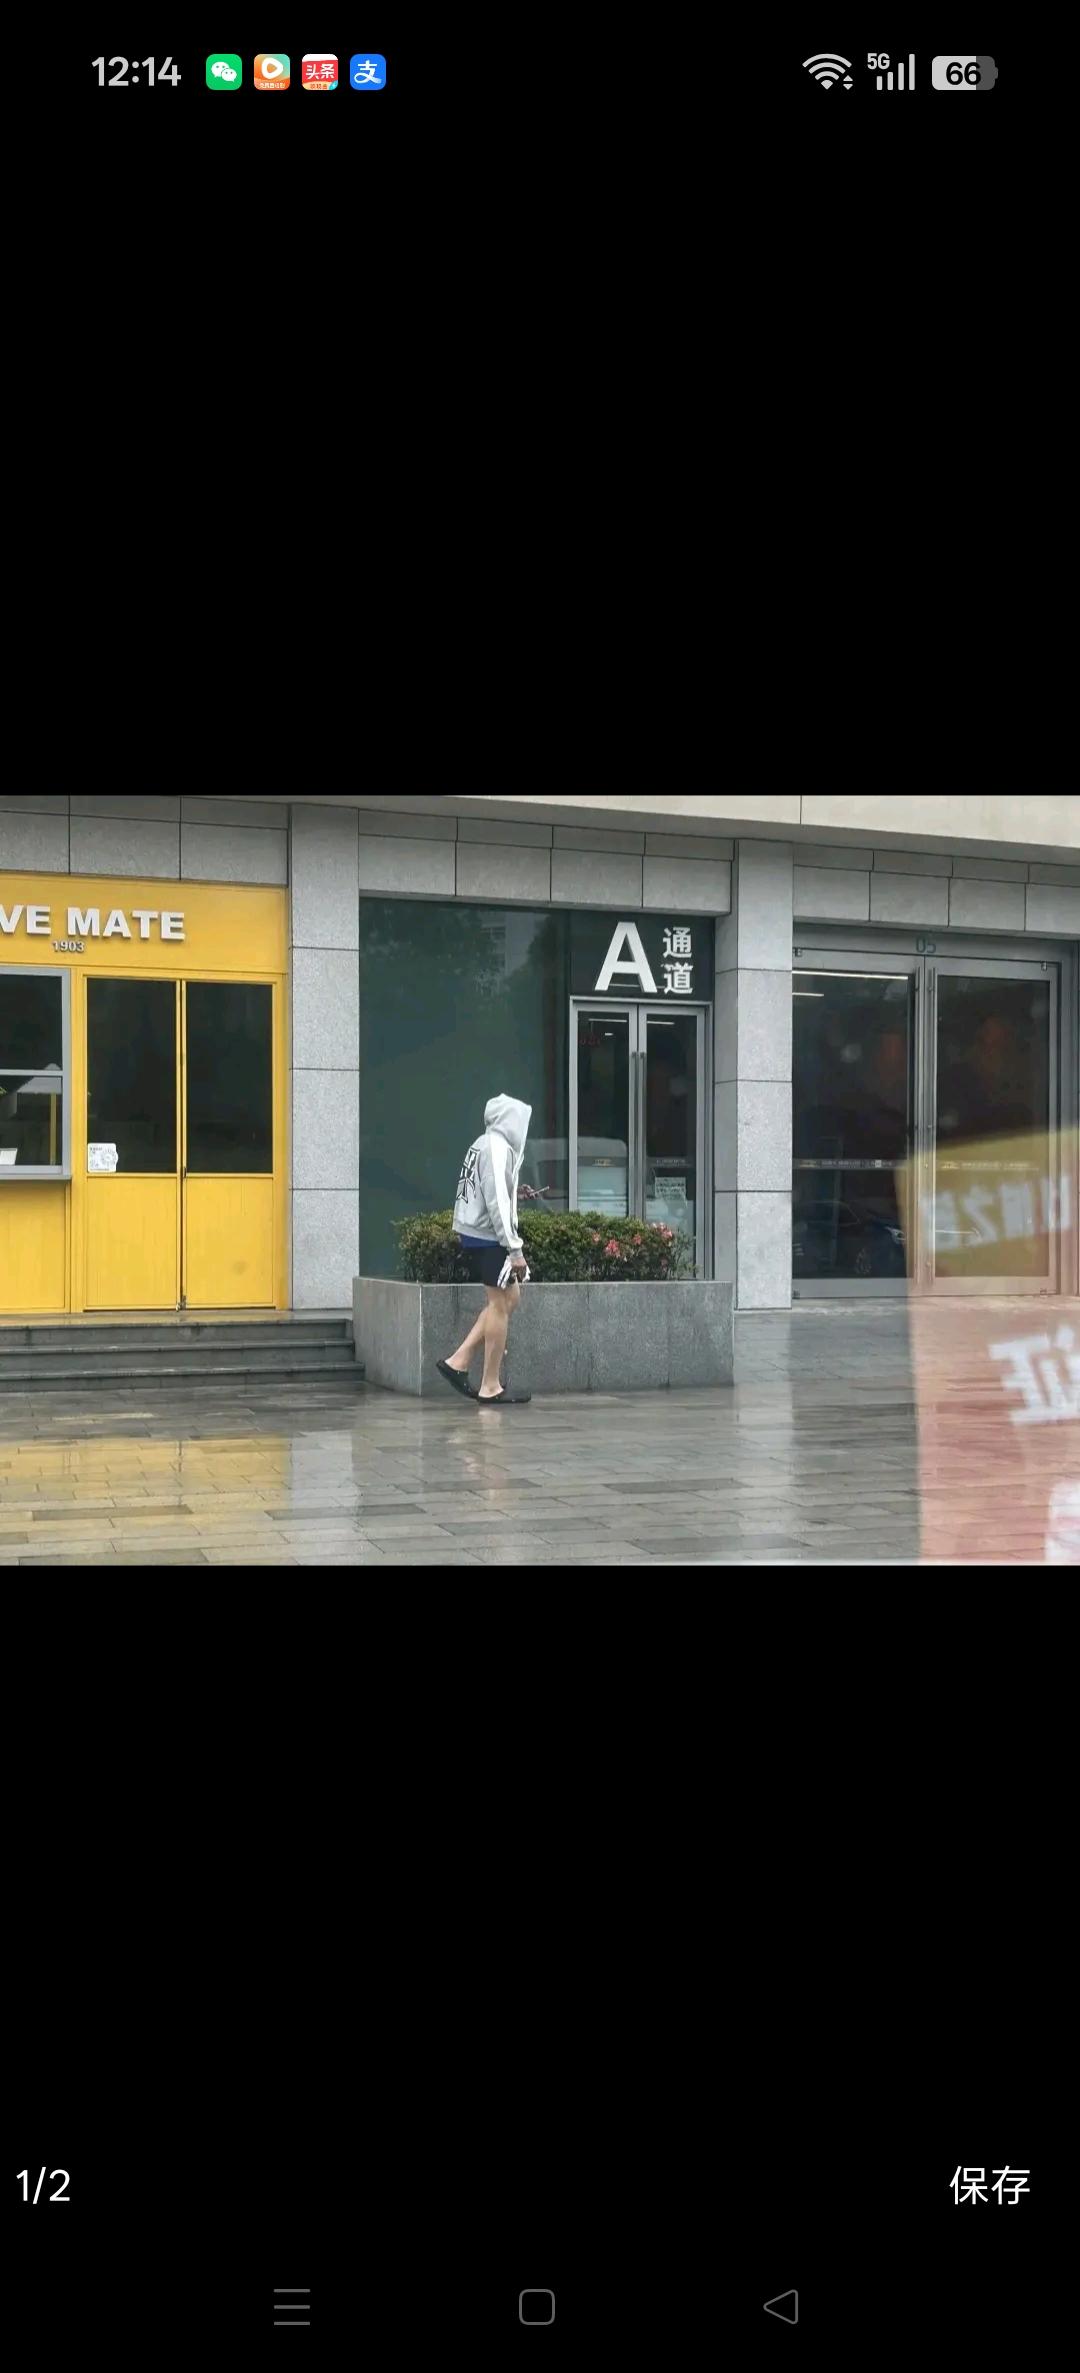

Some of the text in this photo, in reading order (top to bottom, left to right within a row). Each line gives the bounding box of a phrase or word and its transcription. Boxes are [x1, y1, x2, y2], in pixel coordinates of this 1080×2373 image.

[67, 907, 185, 941] MATE
[53, 940, 85, 953] 1903
[594, 921, 693, 994] A 通道
